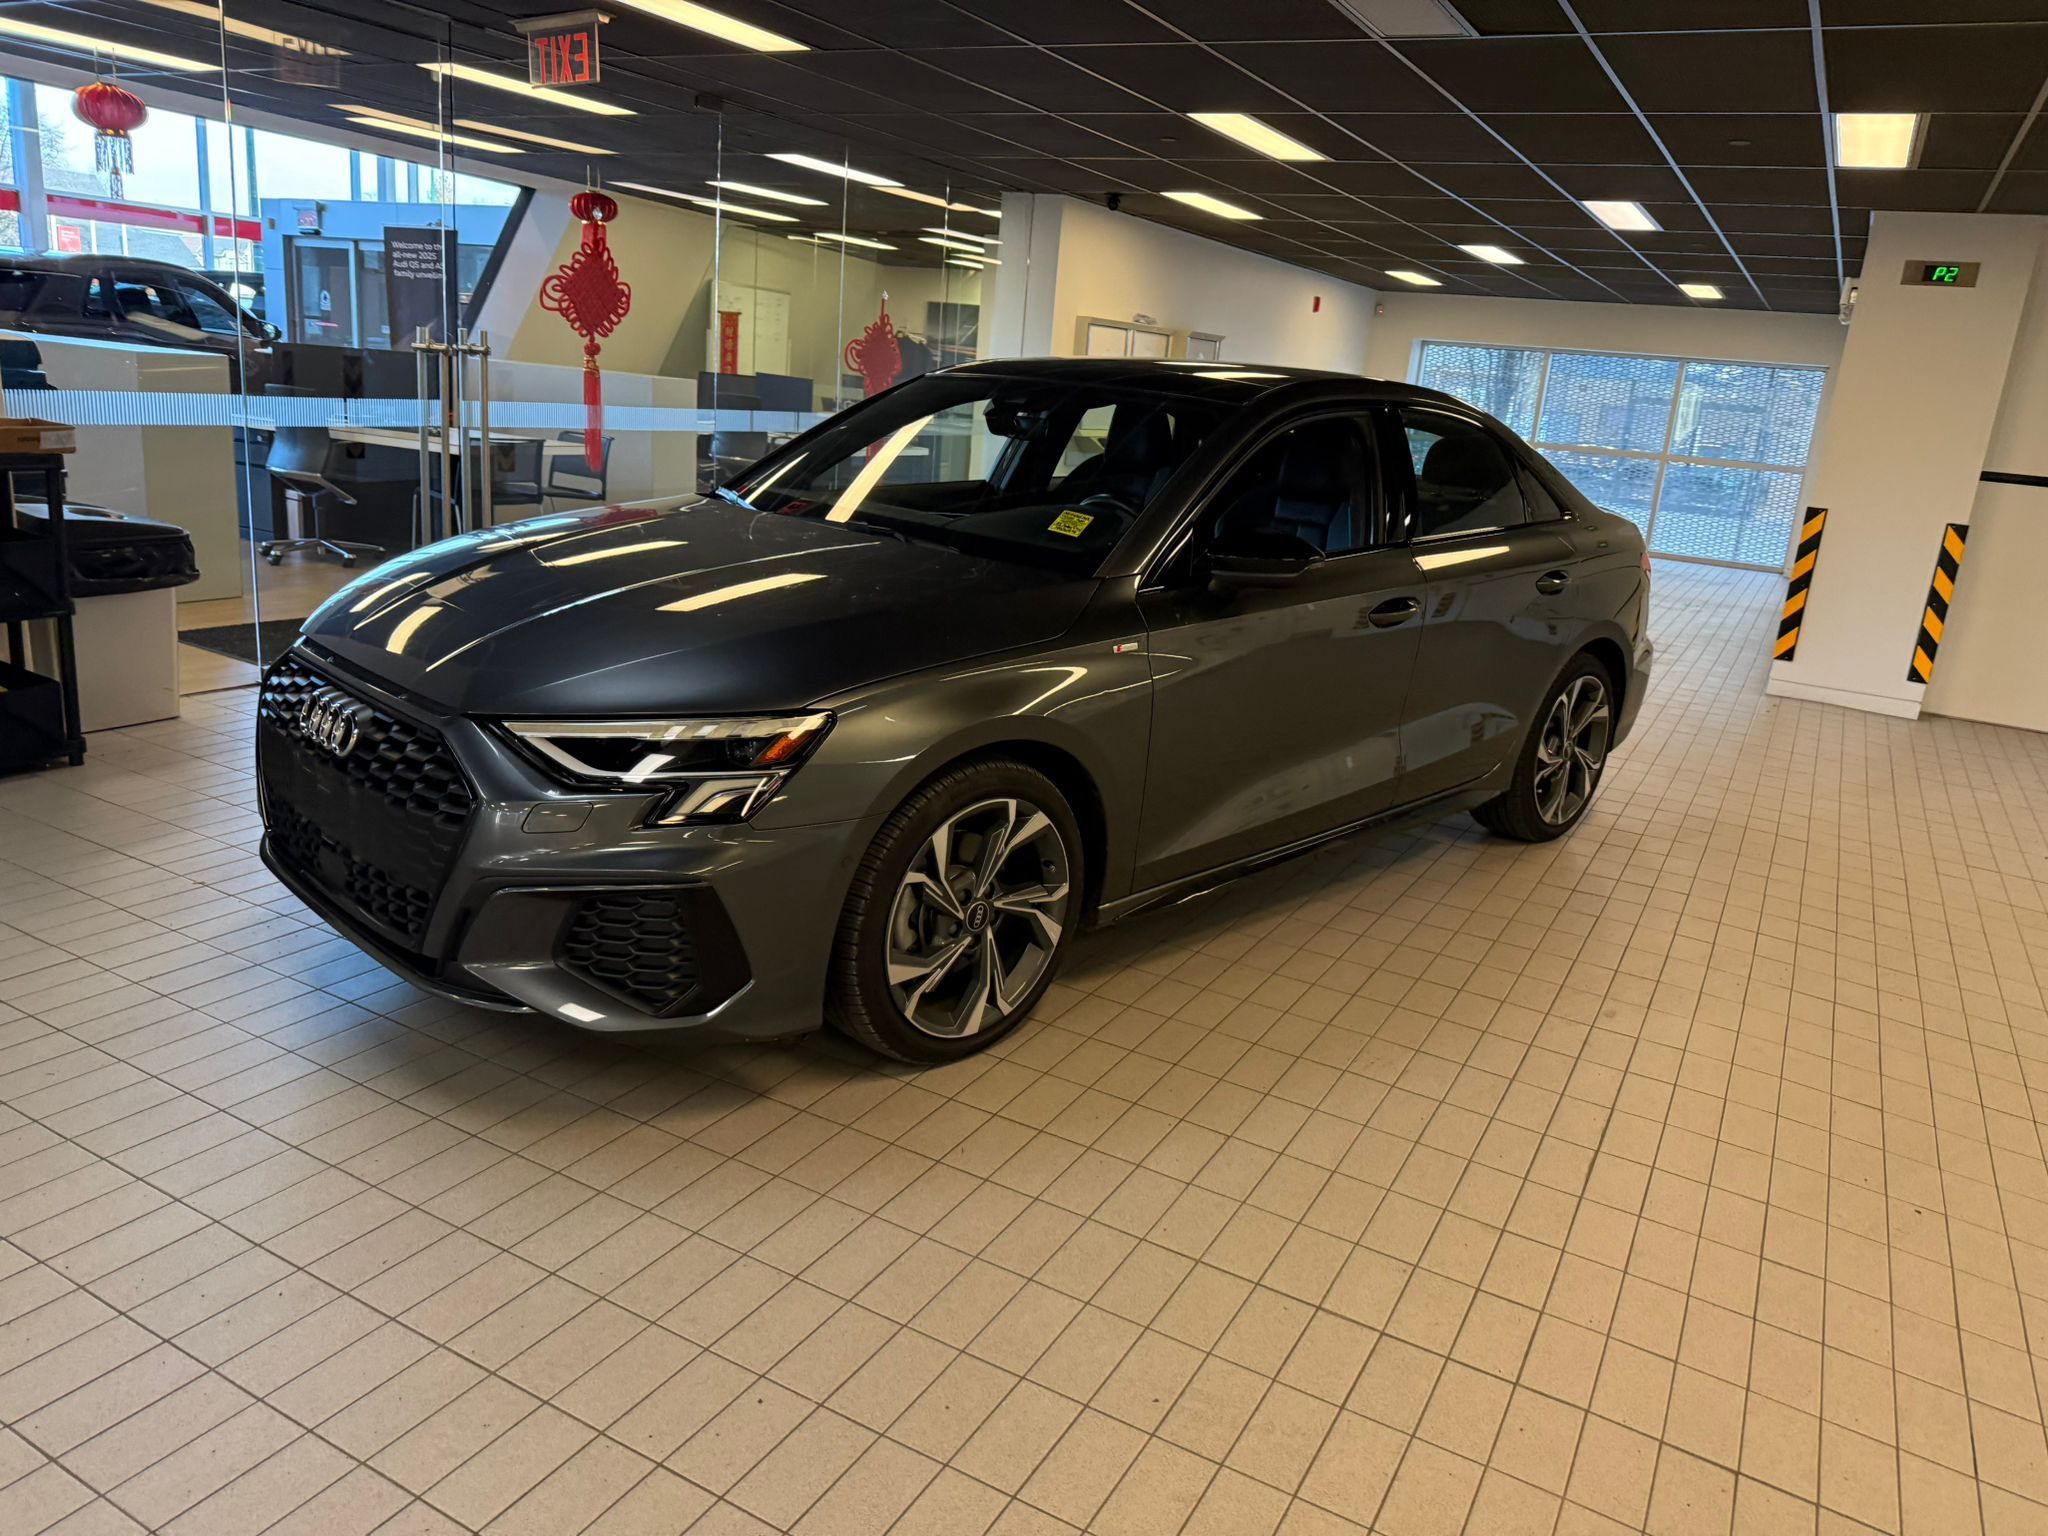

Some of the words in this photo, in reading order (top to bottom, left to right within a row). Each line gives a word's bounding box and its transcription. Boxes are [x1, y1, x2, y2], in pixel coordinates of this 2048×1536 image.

[391, 241, 423, 250] Welcome
[392, 251, 417, 259] all-new
[418, 251, 437, 260] 2025
[393, 260, 408, 268] Audi
[409, 261, 420, 269] Q5
[393, 269, 414, 279] family
[1932, 267, 1959, 282] P2
